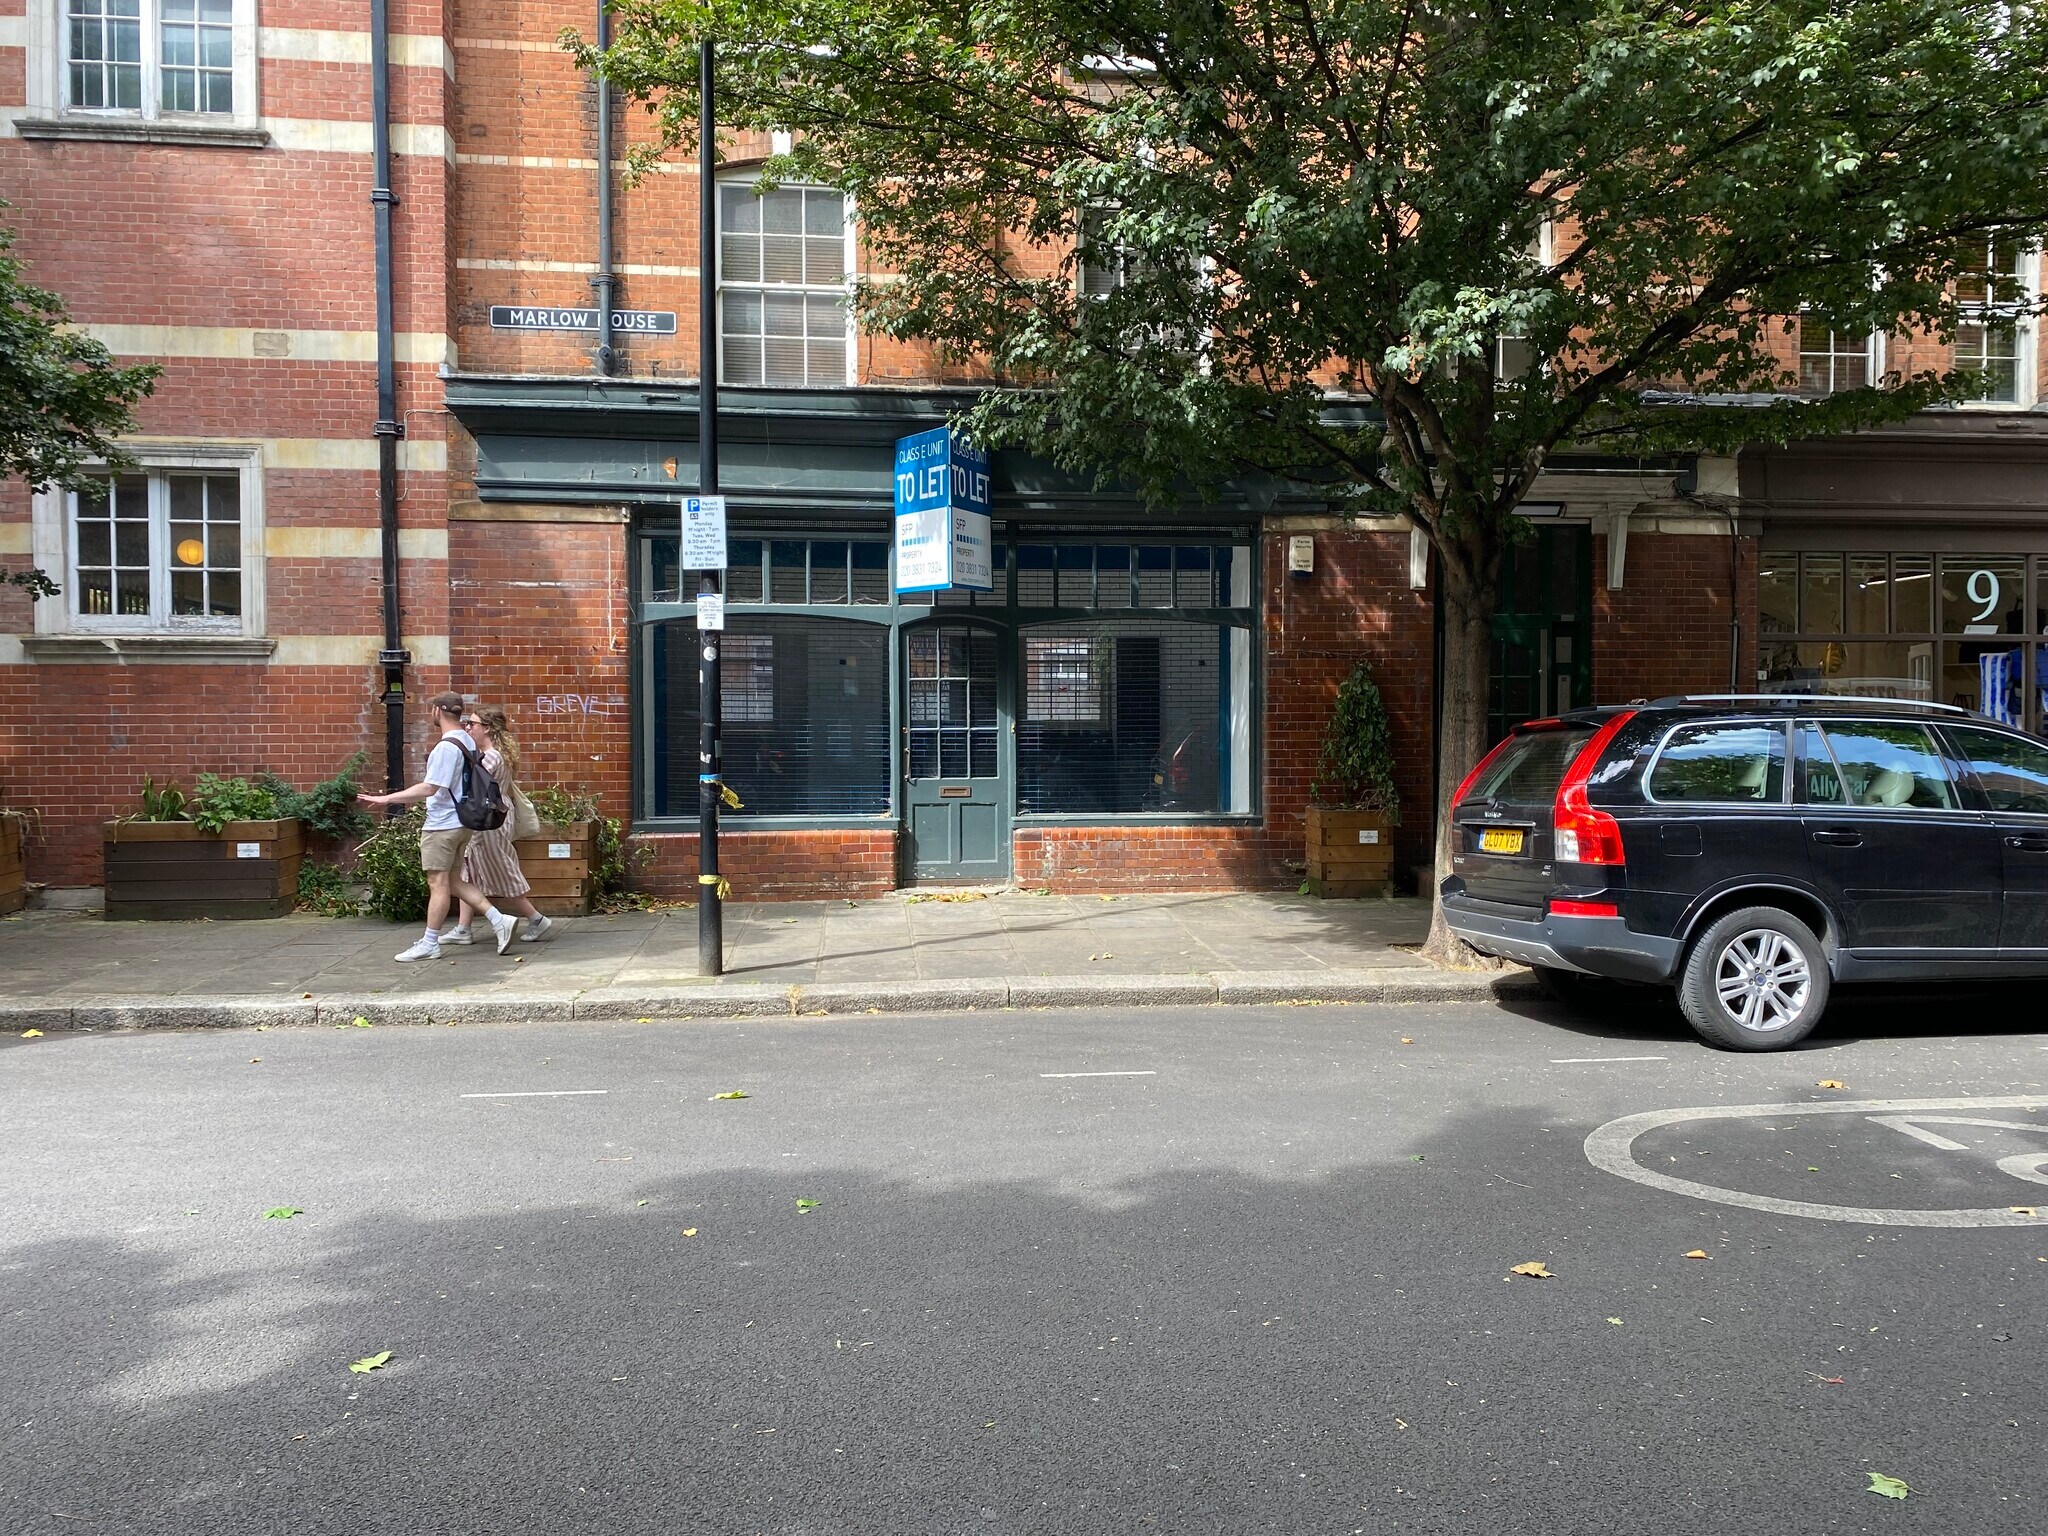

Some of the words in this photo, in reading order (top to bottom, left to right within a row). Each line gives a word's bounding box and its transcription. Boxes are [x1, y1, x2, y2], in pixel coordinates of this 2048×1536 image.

[510, 309, 588, 327] MARLOW
[597, 312, 657, 329] OUSE
[899, 446, 919, 464] CLASS
[921, 444, 926, 459] E
[927, 440, 944, 457] UNIT
[897, 472, 915, 504] TO
[919, 463, 947, 500] LET
[951, 463, 967, 498] TO
[969, 470, 990, 504] LET
[691, 500, 699, 511] P
[901, 523, 913, 536] SFP
[955, 518, 966, 531] SFP
[901, 549, 923, 559] PROPERTY
[956, 547, 975, 558] PROPERTY
[901, 565, 911, 577] 020
[927, 561, 943, 574] 7324
[956, 560, 965, 574] 020
[1966, 569, 2000, 622] 9
[1810, 774, 1839, 801] Ally
